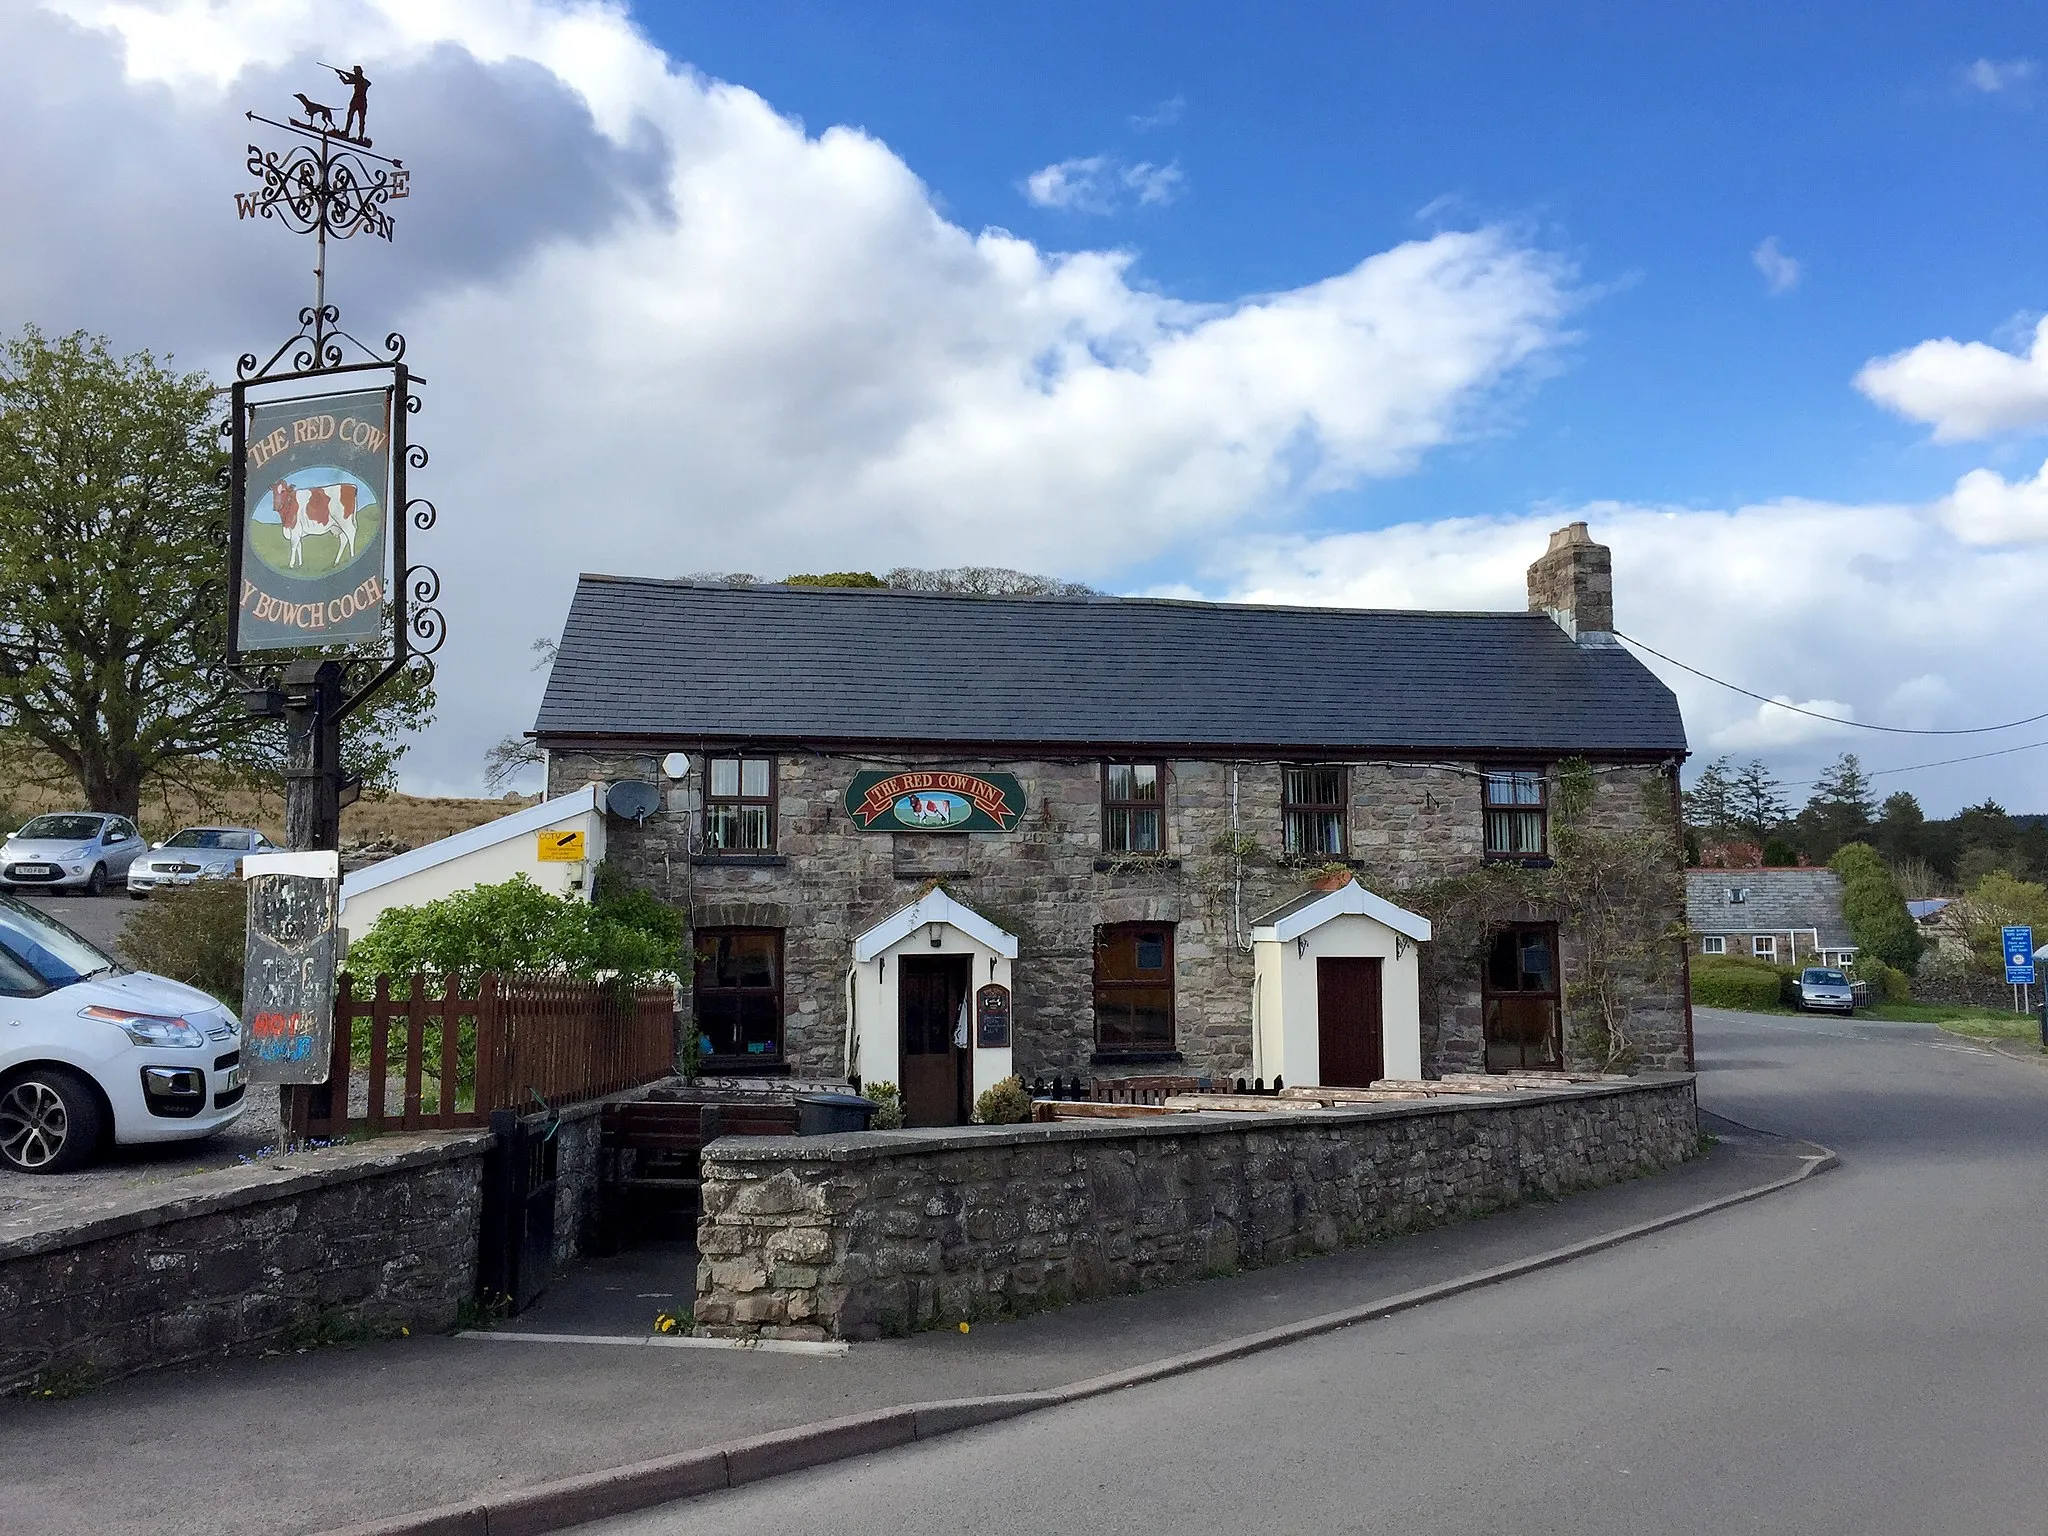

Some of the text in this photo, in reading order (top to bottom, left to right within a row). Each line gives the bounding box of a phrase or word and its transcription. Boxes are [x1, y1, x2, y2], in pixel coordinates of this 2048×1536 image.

[389, 170, 410, 199] E
[233, 191, 260, 220] W
[376, 210, 396, 243] N
[248, 414, 387, 469] THE RED COW
[239, 575, 384, 629] Y BUWCH COCH
[871, 775, 998, 801] THE RED COW INN
[539, 832, 562, 840] CCTV
